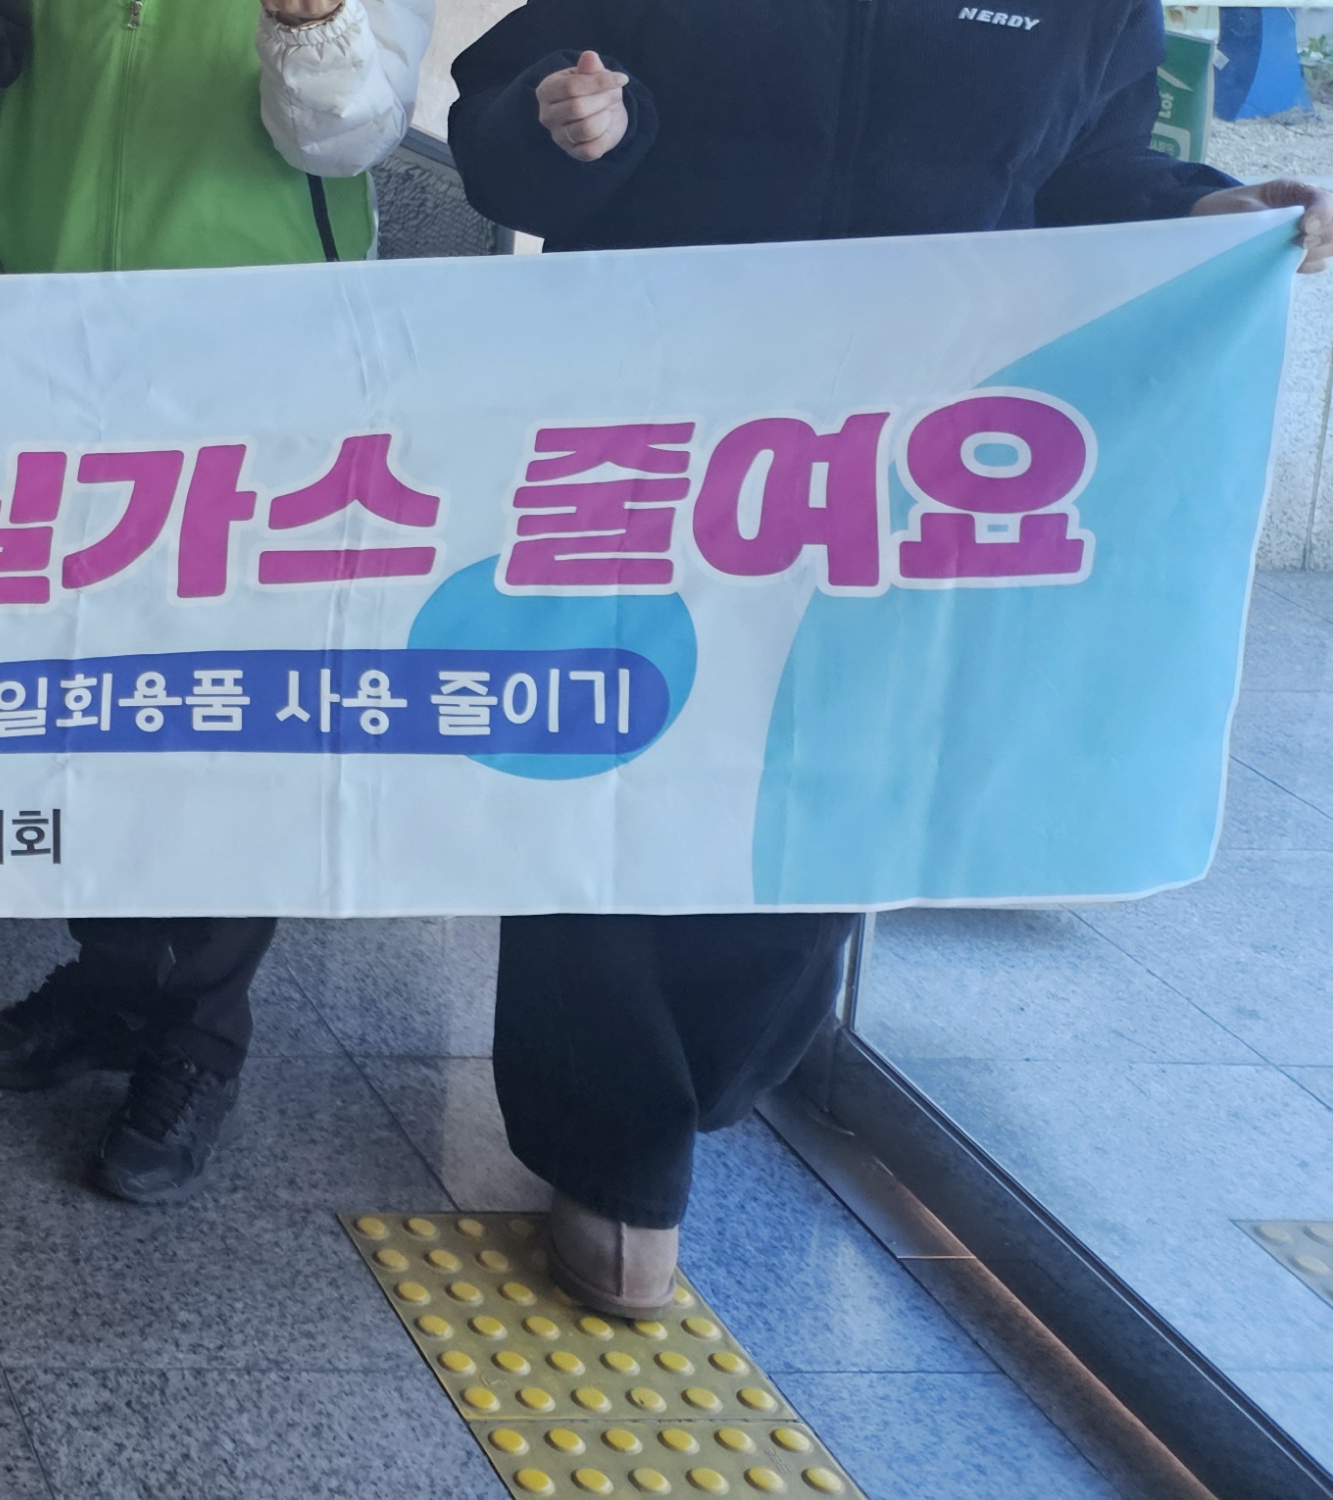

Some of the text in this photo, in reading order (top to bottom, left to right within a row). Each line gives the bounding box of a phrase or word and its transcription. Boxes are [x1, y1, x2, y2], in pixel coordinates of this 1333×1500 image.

[958, 7, 1040, 31] NERDY
[504, 394, 1089, 590] 줄여요
[274, 667, 410, 737] 사용
[429, 665, 632, 738] 줄이기
